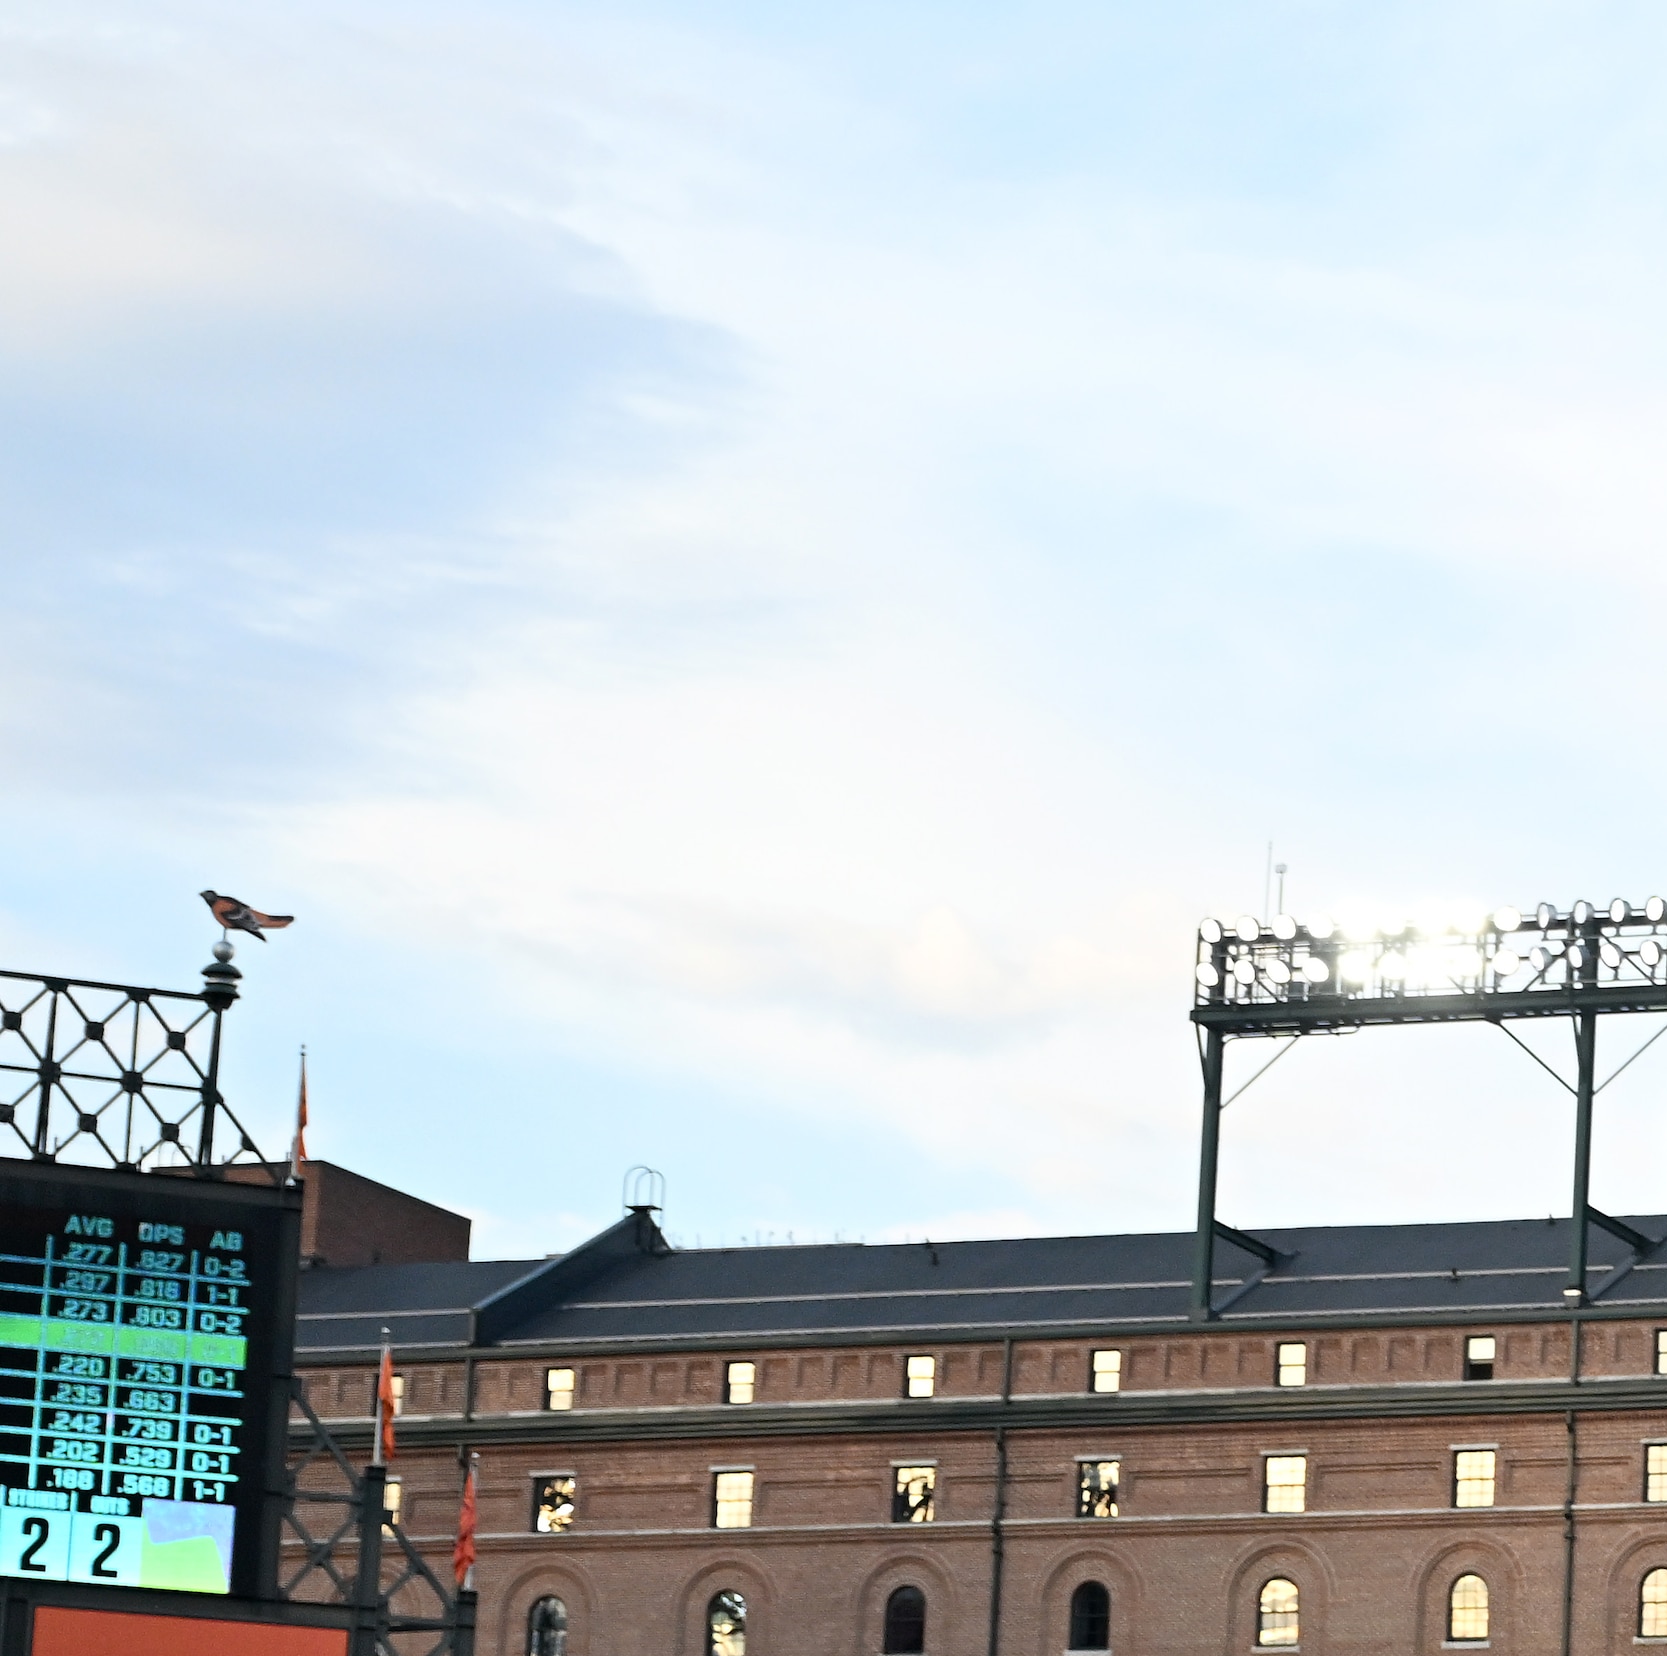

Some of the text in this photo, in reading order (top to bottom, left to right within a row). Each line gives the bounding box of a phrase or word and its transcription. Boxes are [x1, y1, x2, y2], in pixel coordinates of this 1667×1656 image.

[64, 1214, 243, 1251] AVG OPS AB
[204, 1256, 246, 1279] 0-2
[207, 1285, 239, 1306] 1-1
[200, 1312, 242, 1335] 0-2
[52, 1354, 235, 1389] .220 .753 0-1
[51, 1383, 103, 1405] .235
[49, 1411, 231, 1445] .242 .739 0-1
[46, 1440, 229, 1474] .202 .529 0-1
[193, 1480, 225, 1502] 1-1
[20, 1517, 49, 1572] 2
[92, 1523, 120, 1578] 2
